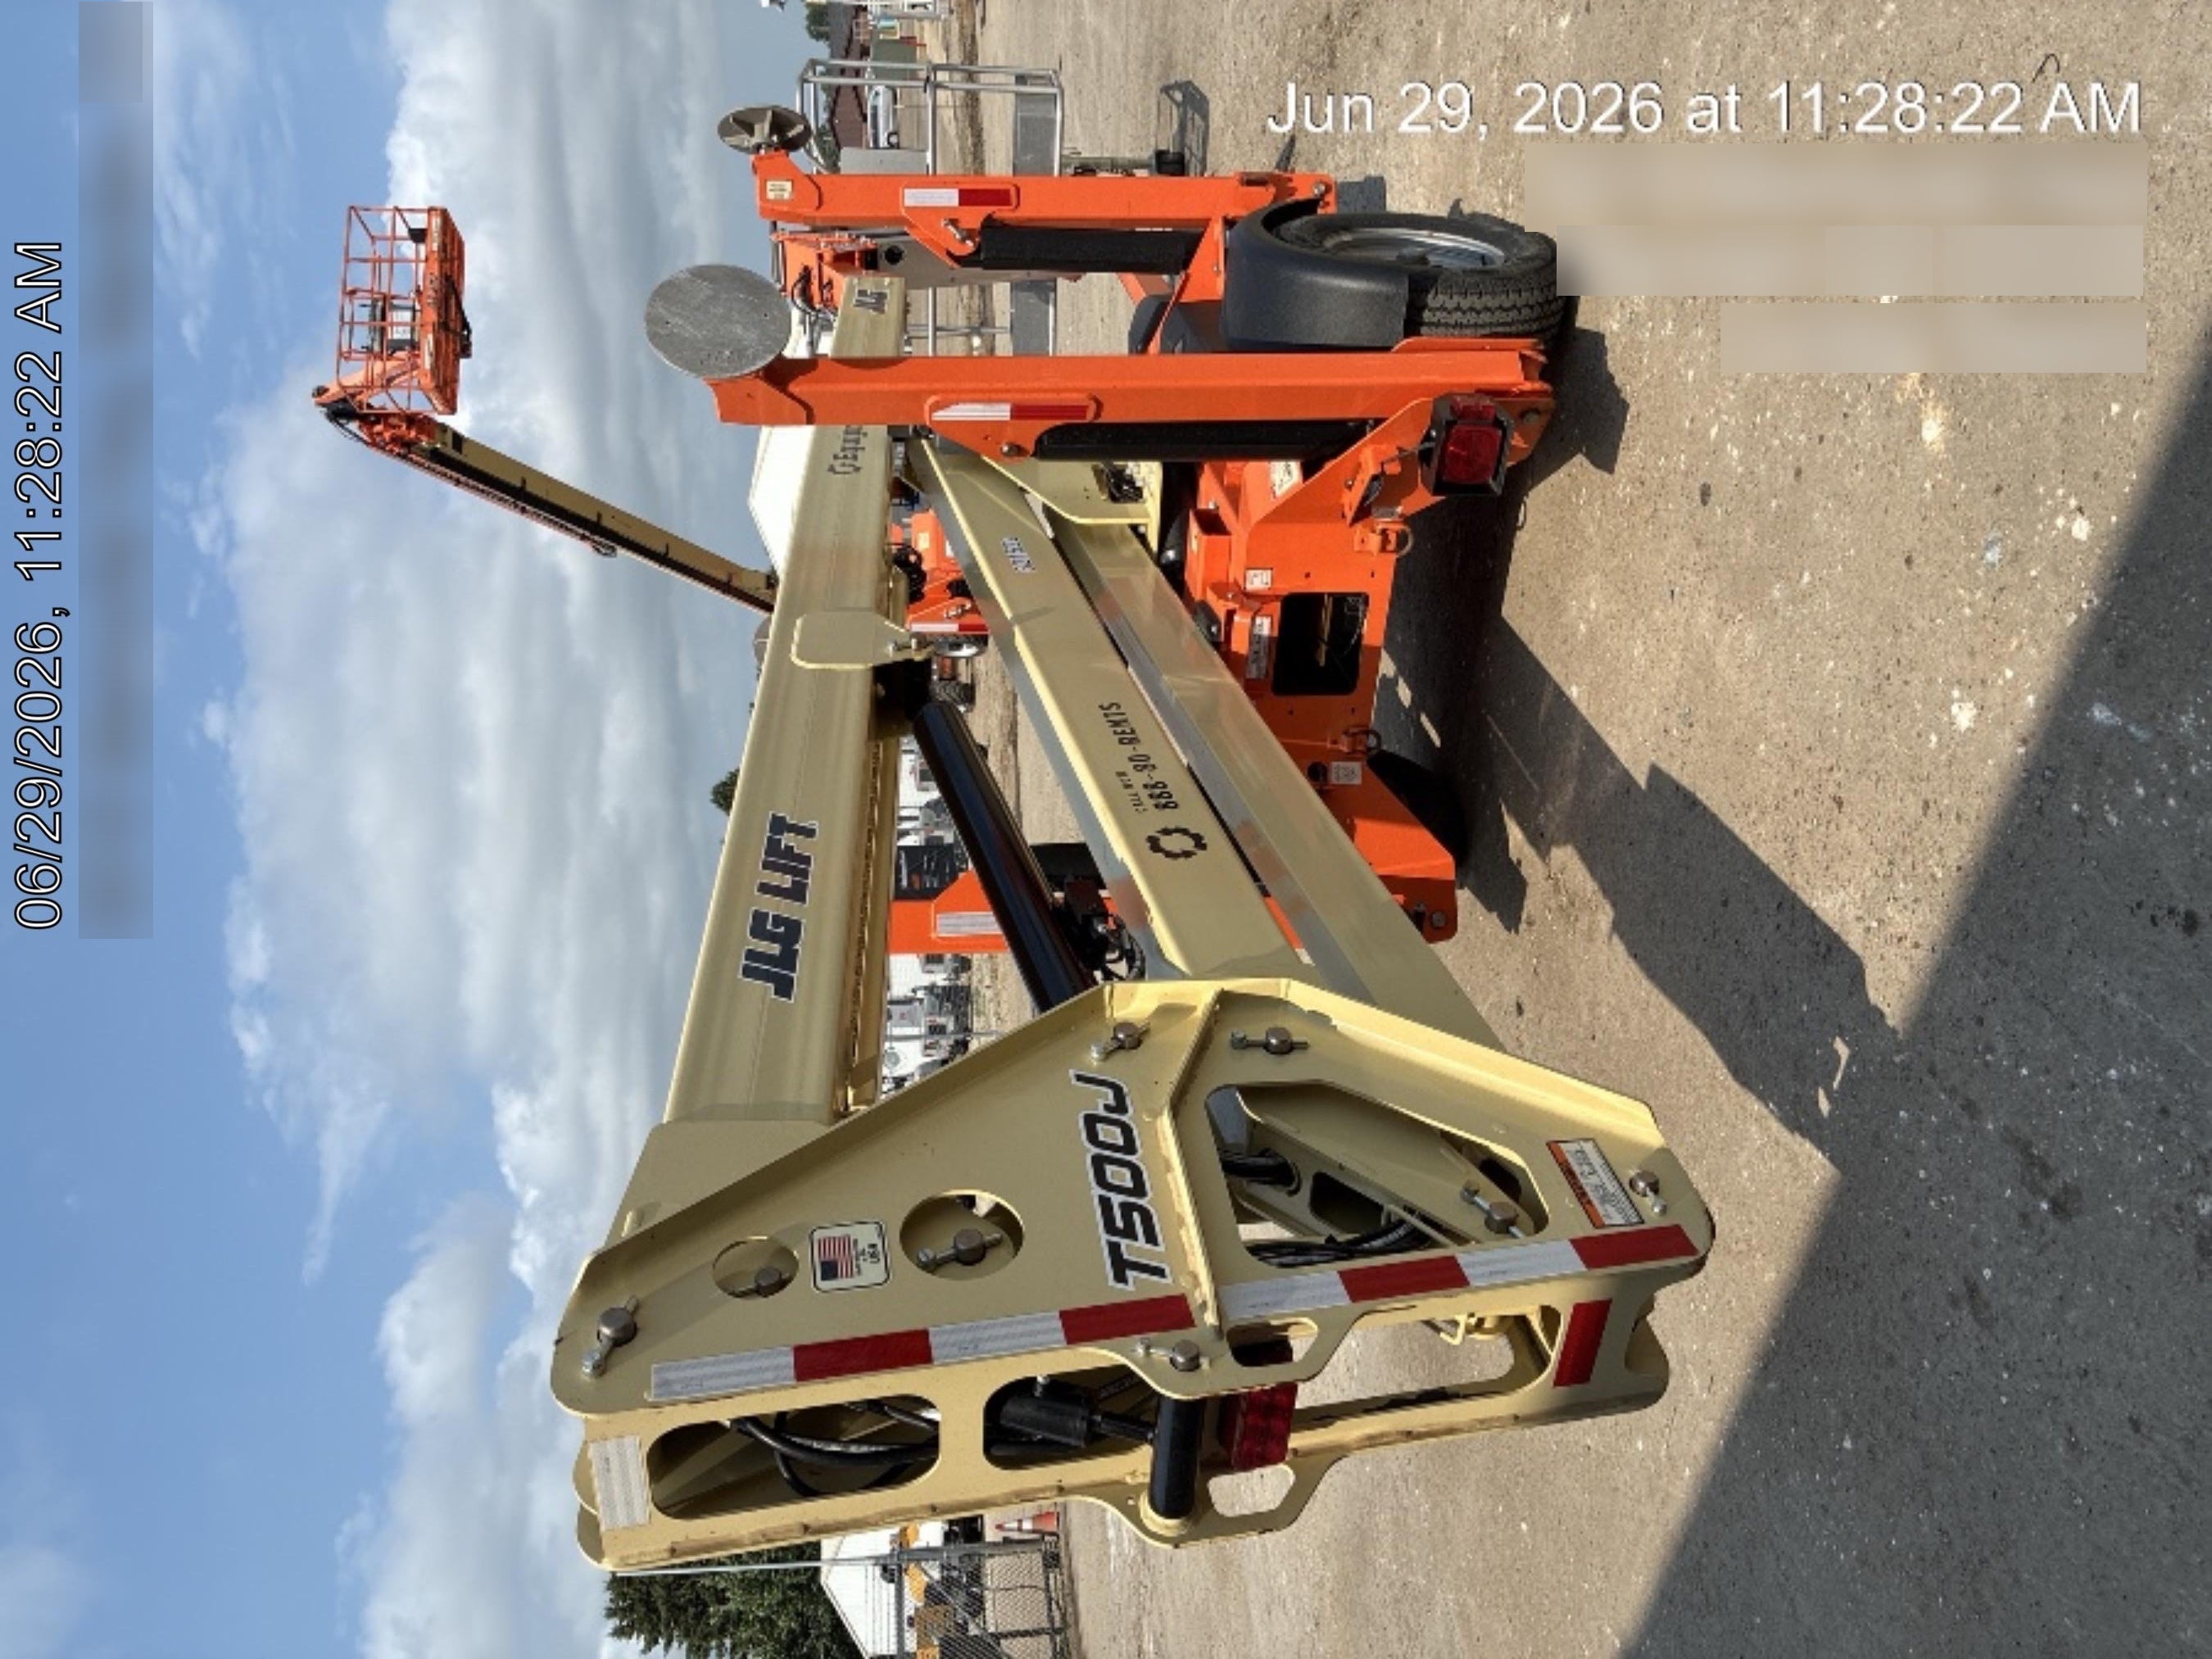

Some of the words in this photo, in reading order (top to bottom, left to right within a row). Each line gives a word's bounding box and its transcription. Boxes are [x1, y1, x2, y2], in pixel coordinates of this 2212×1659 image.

[754, 811, 818, 907] LIFT
[738, 907, 805, 1003] JLG
[1068, 1069, 1173, 1290] T500J
